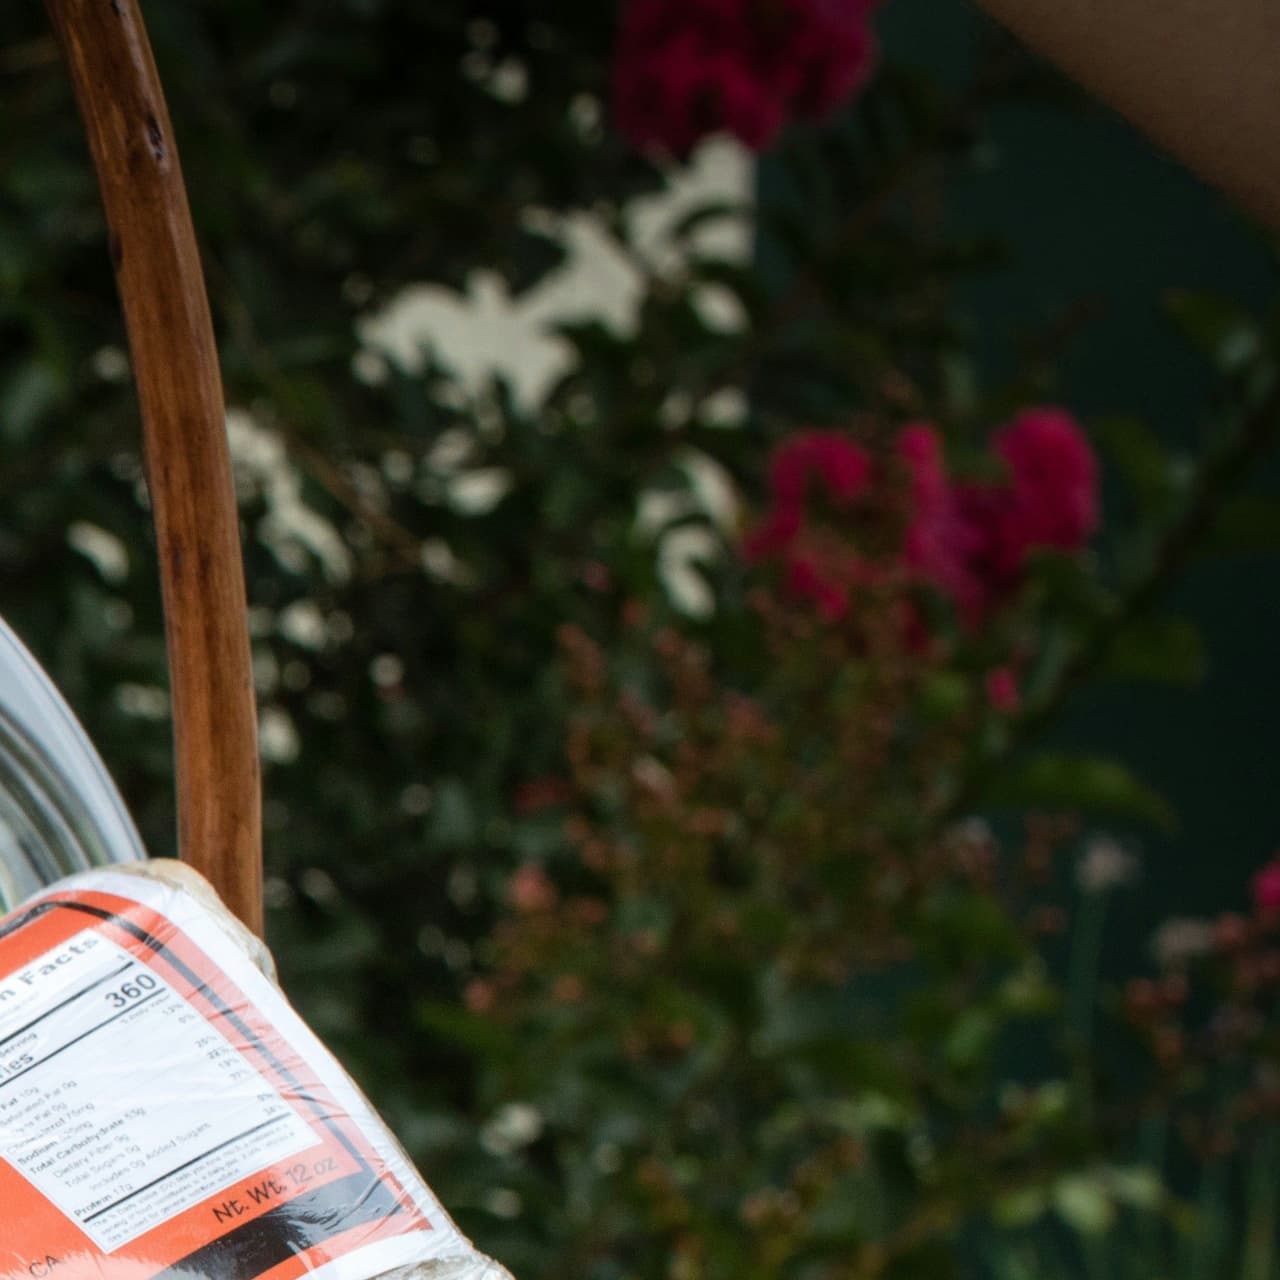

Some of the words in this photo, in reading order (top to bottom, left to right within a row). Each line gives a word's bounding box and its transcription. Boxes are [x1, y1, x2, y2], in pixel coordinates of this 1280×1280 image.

[19, 938, 100, 986] Facts
[105, 973, 157, 1009] 360
[212, 1200, 250, 1224] Nt.
[246, 1180, 288, 1206] Wt.
[285, 1162, 313, 1186] 12
[314, 1158, 338, 1174] oz
[28, 1255, 62, 1279] CA
